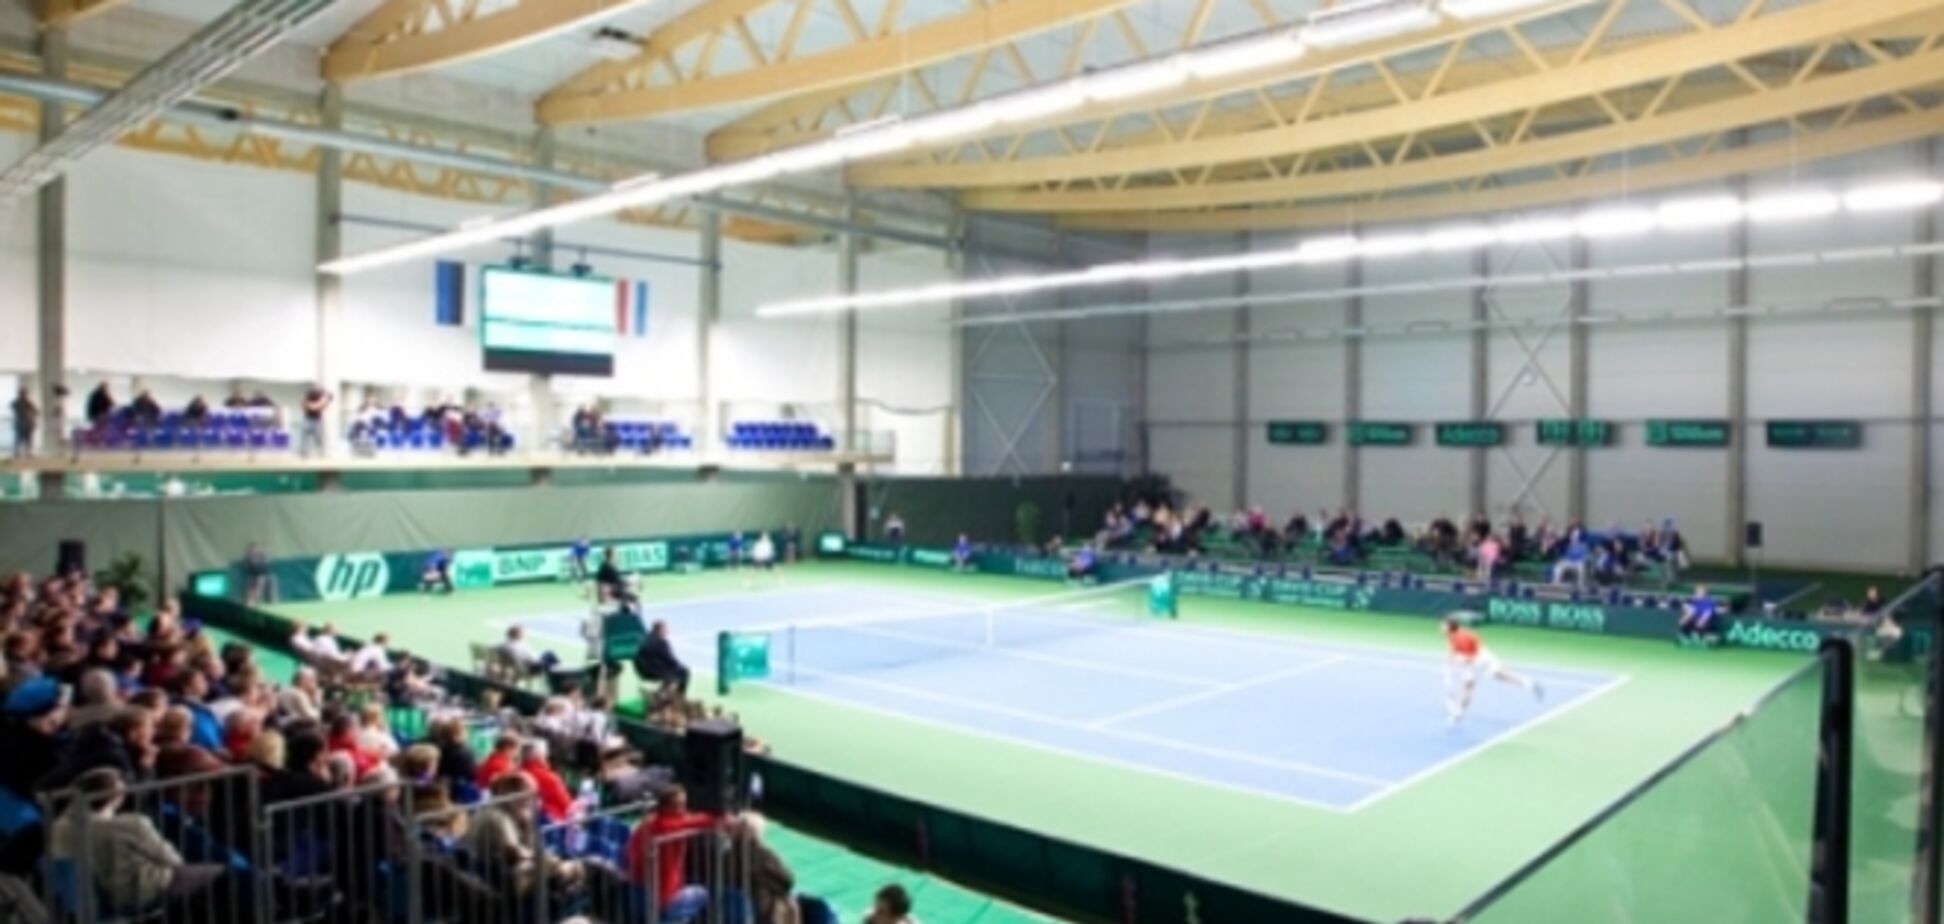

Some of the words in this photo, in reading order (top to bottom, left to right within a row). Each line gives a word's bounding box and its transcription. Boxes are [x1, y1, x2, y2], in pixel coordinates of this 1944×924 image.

[327, 553, 381, 597] hp
[498, 552, 546, 574] BNP
[1489, 598, 1540, 621] BOSS
[1548, 603, 1604, 628] BOSS
[1727, 621, 1820, 649] Adecco
